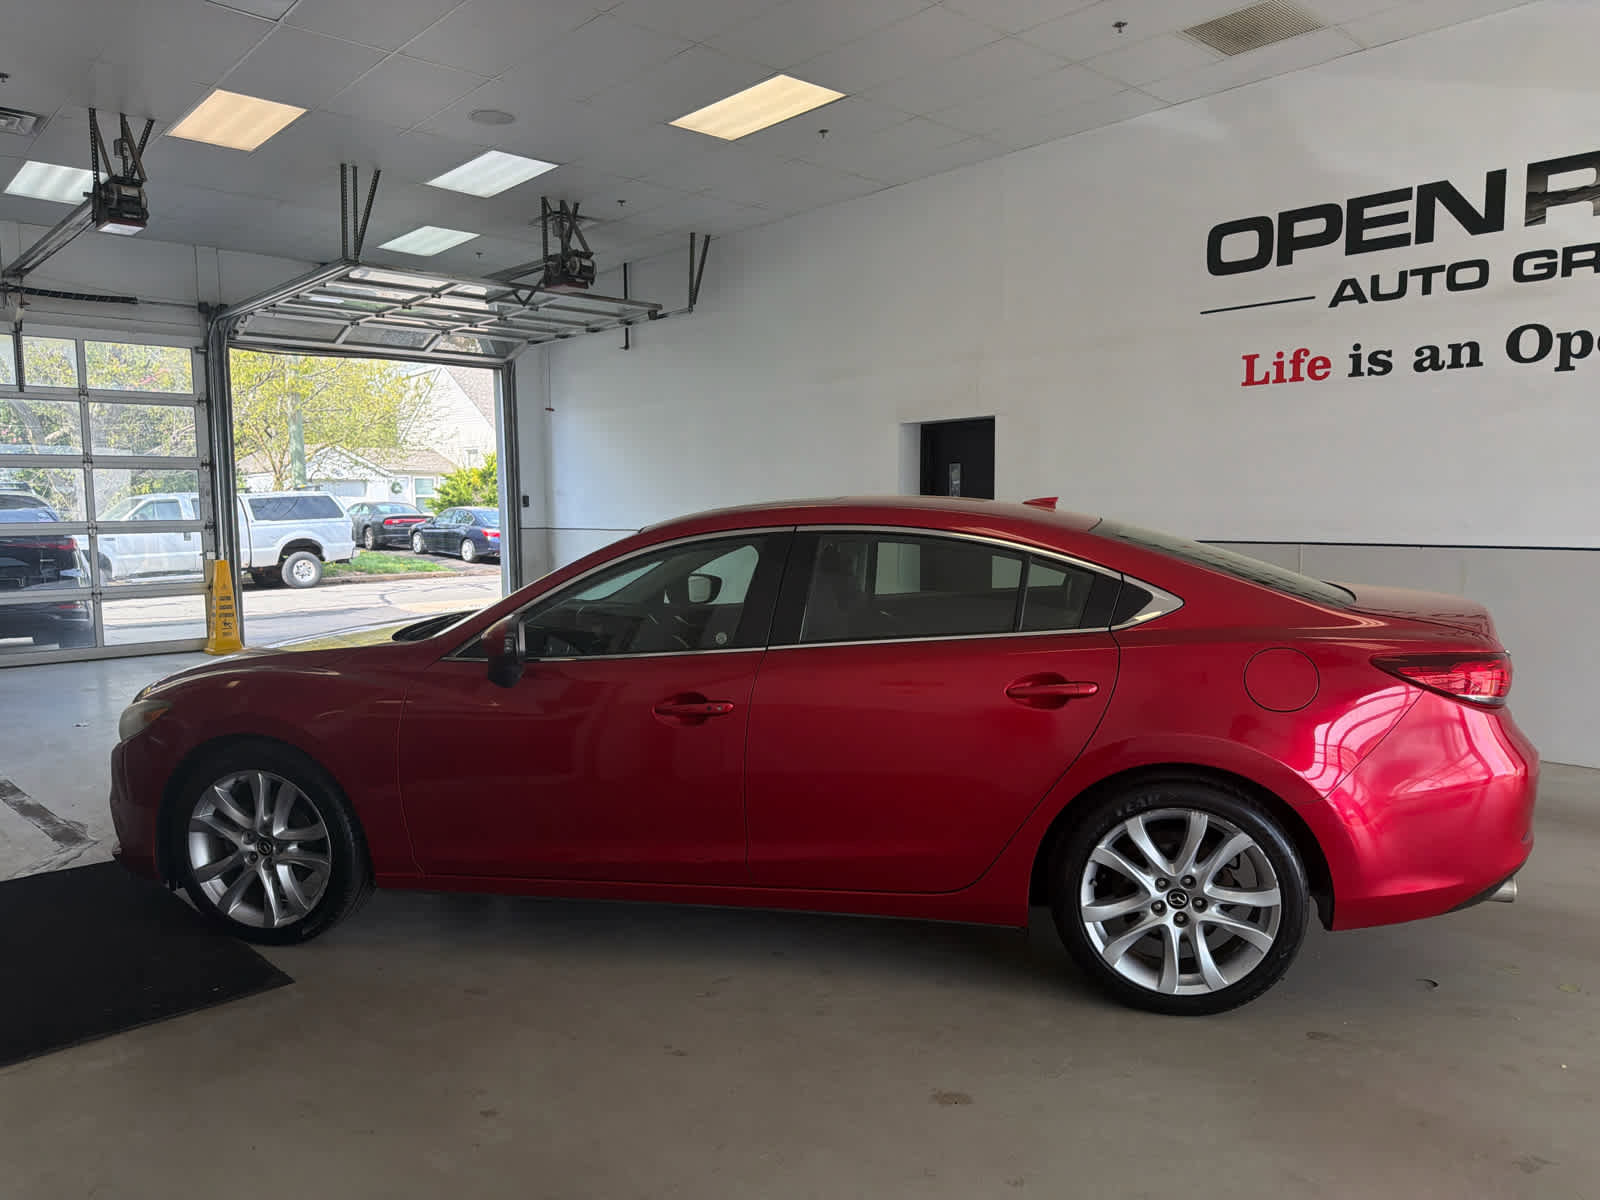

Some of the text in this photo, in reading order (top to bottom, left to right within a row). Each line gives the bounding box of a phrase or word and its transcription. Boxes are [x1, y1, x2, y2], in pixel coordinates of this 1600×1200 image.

[1328, 259, 1490, 309] AUTO
[1241, 323, 1600, 387] Life is an Op
